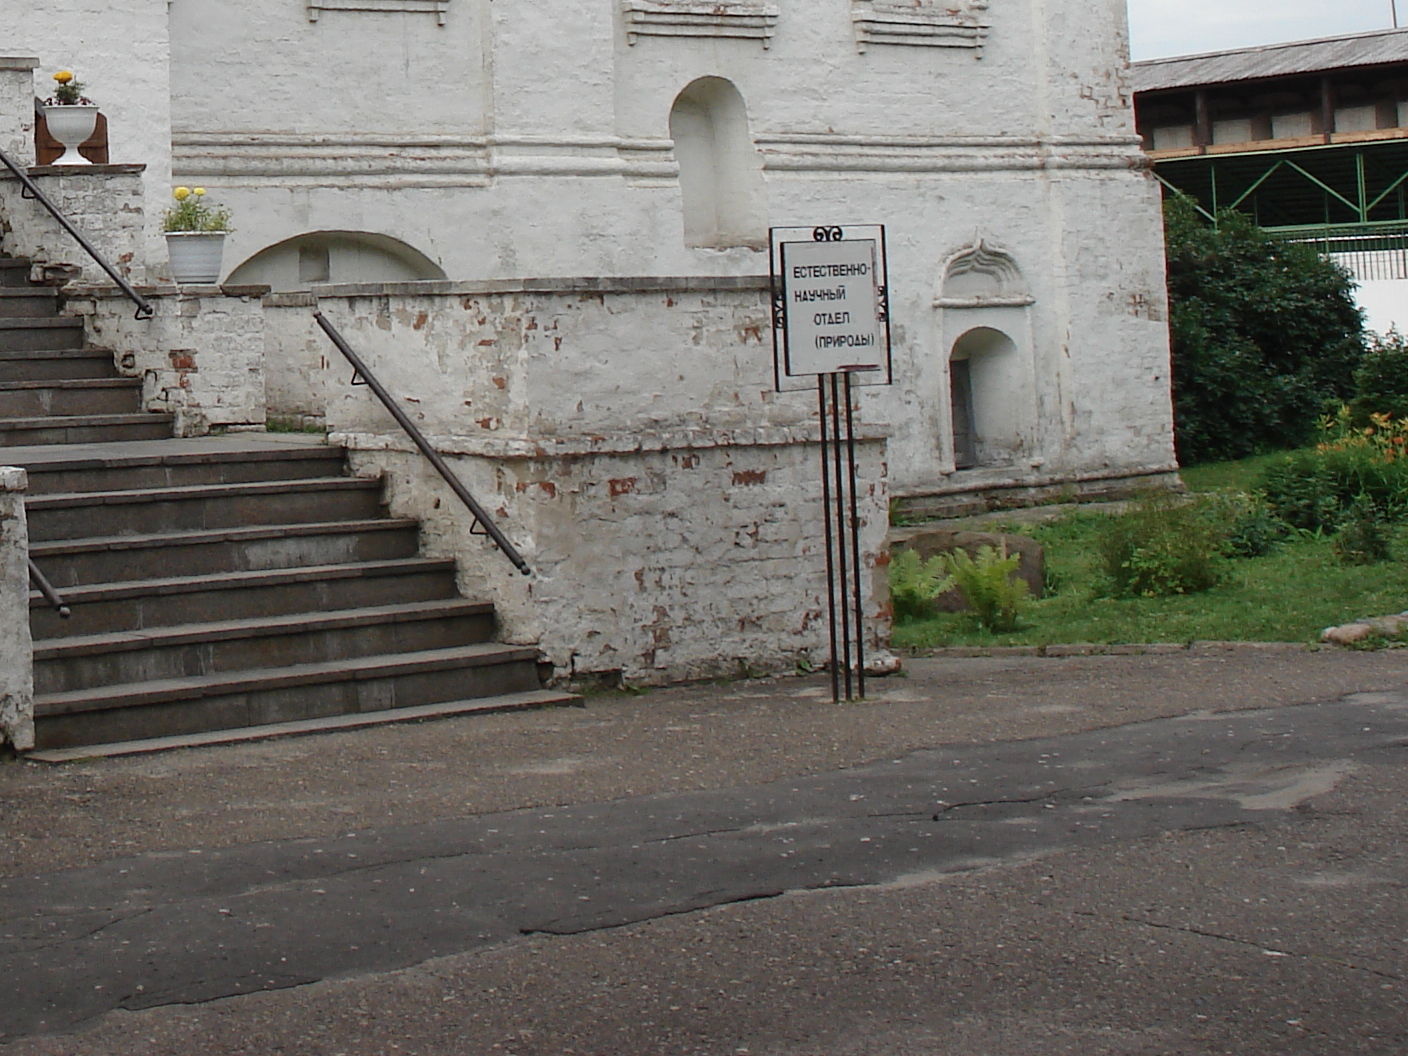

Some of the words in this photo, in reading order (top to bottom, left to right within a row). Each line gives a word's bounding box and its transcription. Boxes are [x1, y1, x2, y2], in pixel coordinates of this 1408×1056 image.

[793, 263, 871, 278] ЕСТЕСТВЕННО-
[794, 285, 846, 302] НАУЧНЫЙ
[814, 311, 850, 325] ОТДЕЛ
[815, 333, 874, 349] (ПРИРОДЫ)
